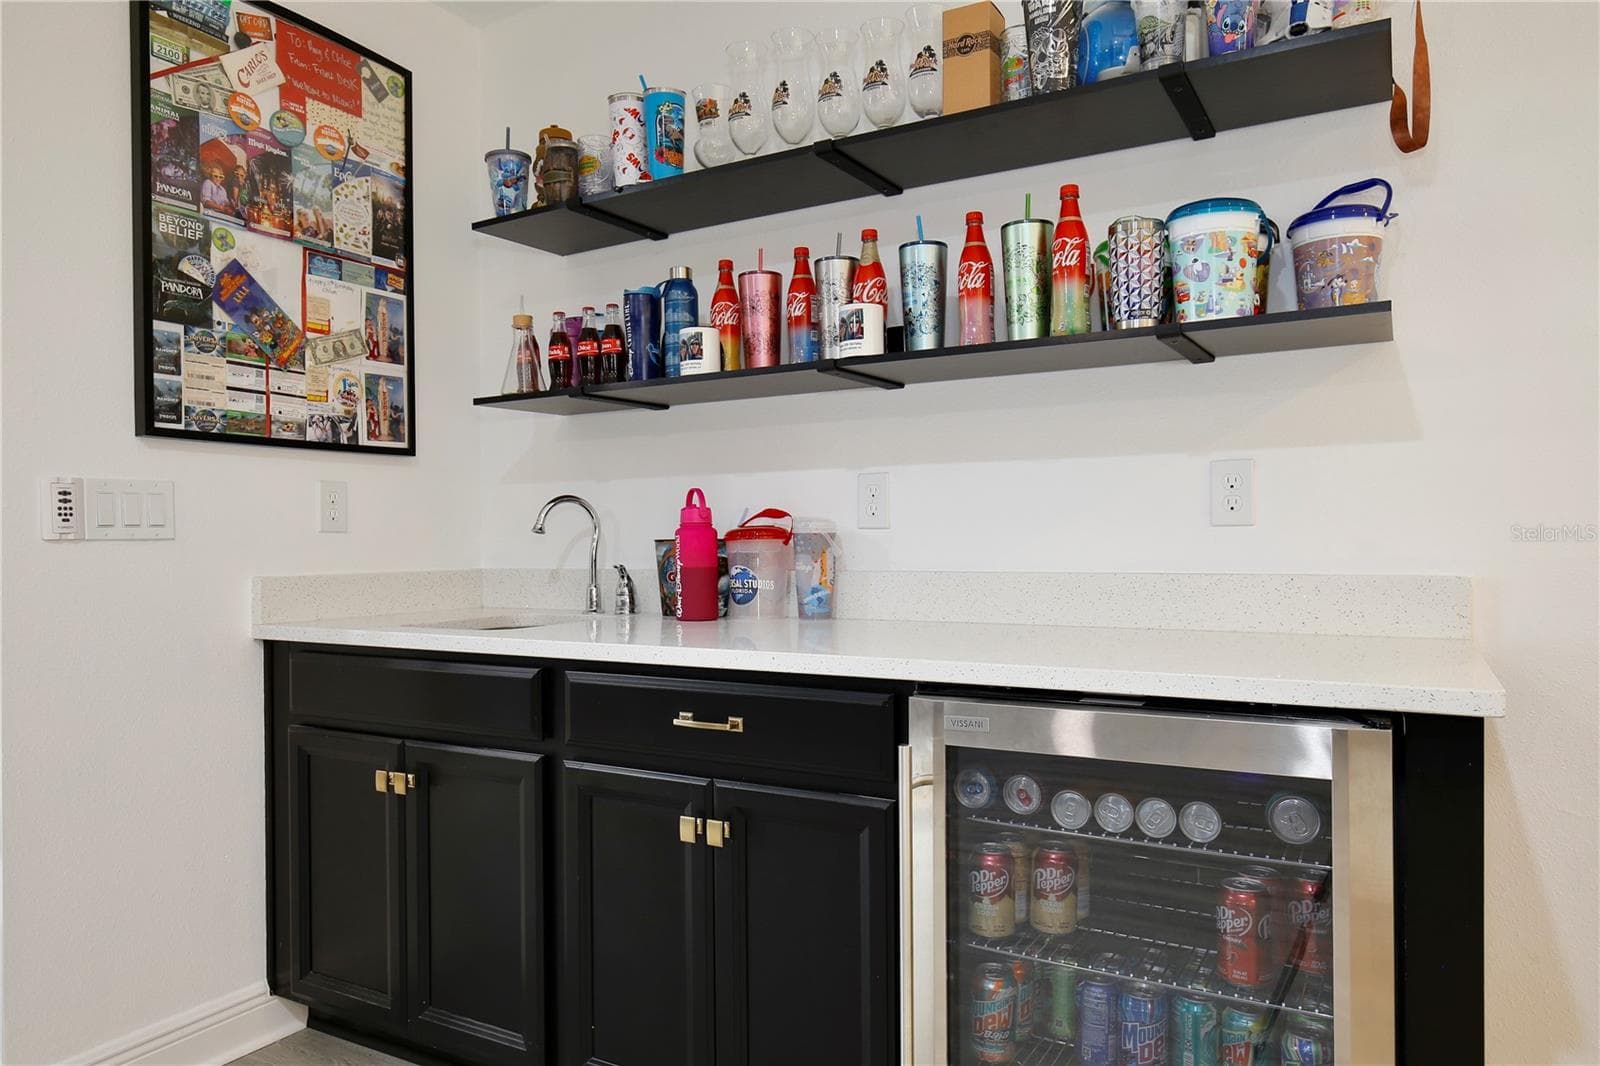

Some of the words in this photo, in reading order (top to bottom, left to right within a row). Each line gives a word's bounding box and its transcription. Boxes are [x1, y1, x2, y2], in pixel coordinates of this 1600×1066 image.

[156, 45, 180, 60] 2100
[159, 213, 203, 231] BEYOND
[159, 222, 204, 240] BELIEF
[745, 579, 775, 590] STUDIOS
[950, 719, 984, 729] VISSANI
[980, 869, 997, 882] Dr
[1034, 868, 1073, 892] Pepper
[1044, 867, 1063, 880] Dr
[969, 870, 1007, 895] Pepper
